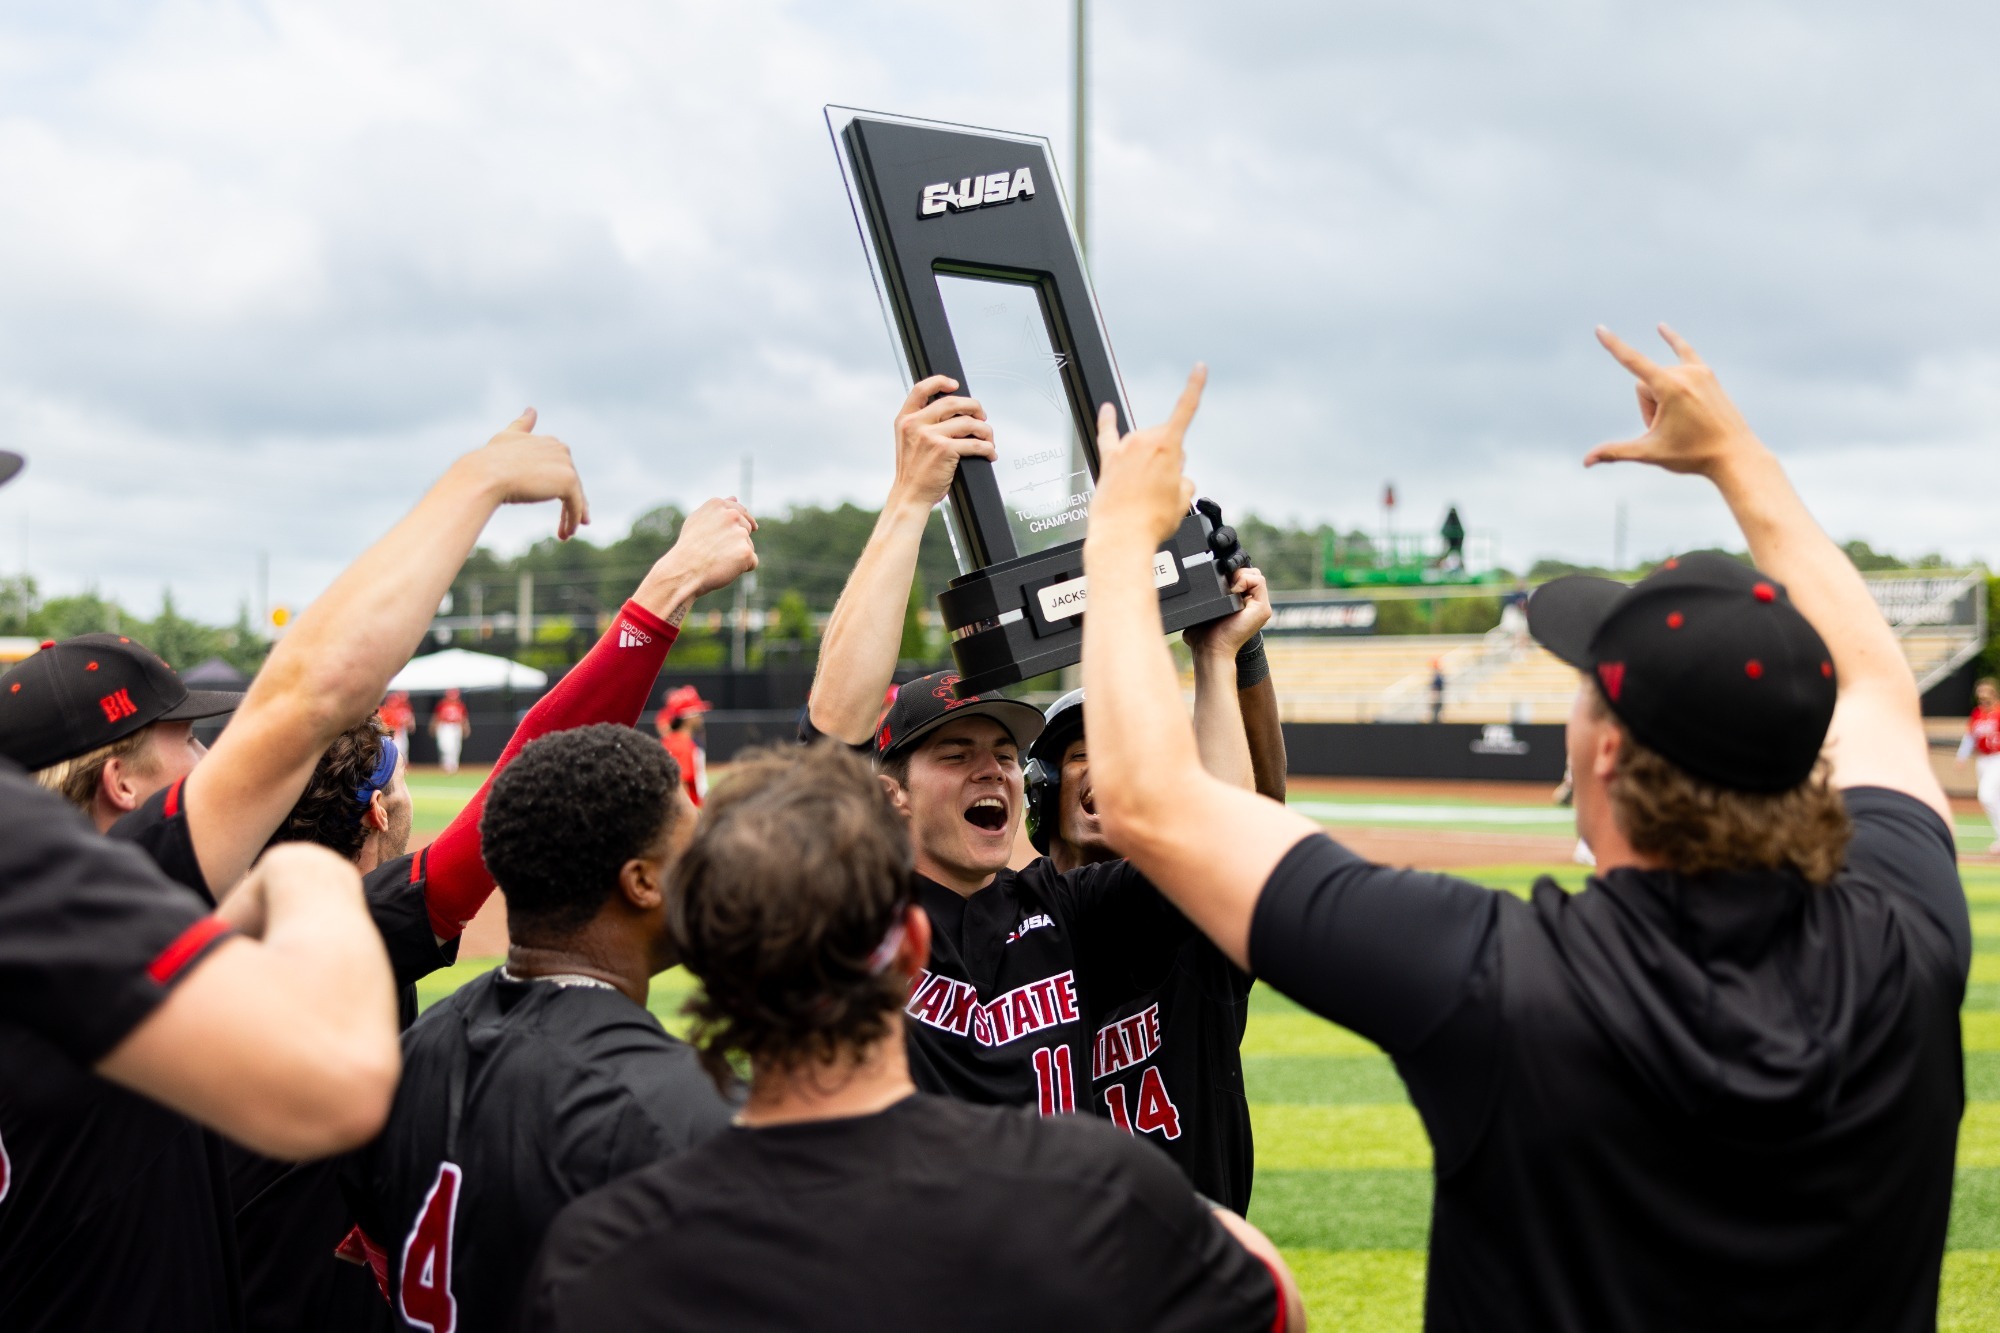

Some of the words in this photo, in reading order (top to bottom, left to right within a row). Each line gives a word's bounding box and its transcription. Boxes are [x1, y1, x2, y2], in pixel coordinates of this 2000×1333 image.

[1014, 447, 1066, 470] BASEBALL
[1016, 490, 1092, 522] TOURNAMENT
[1029, 506, 1089, 533] CHAMPION
[1051, 589, 1087, 608] JACKS
[620, 619, 652, 644] adidas
[100, 687, 138, 723] BK
[974, 969, 1080, 1047] STATE
[1092, 1001, 1162, 1081] TATE
[1032, 1043, 1076, 1120] 11
[1104, 1065, 1182, 1141] 14
[399, 1160, 463, 1333] 4
